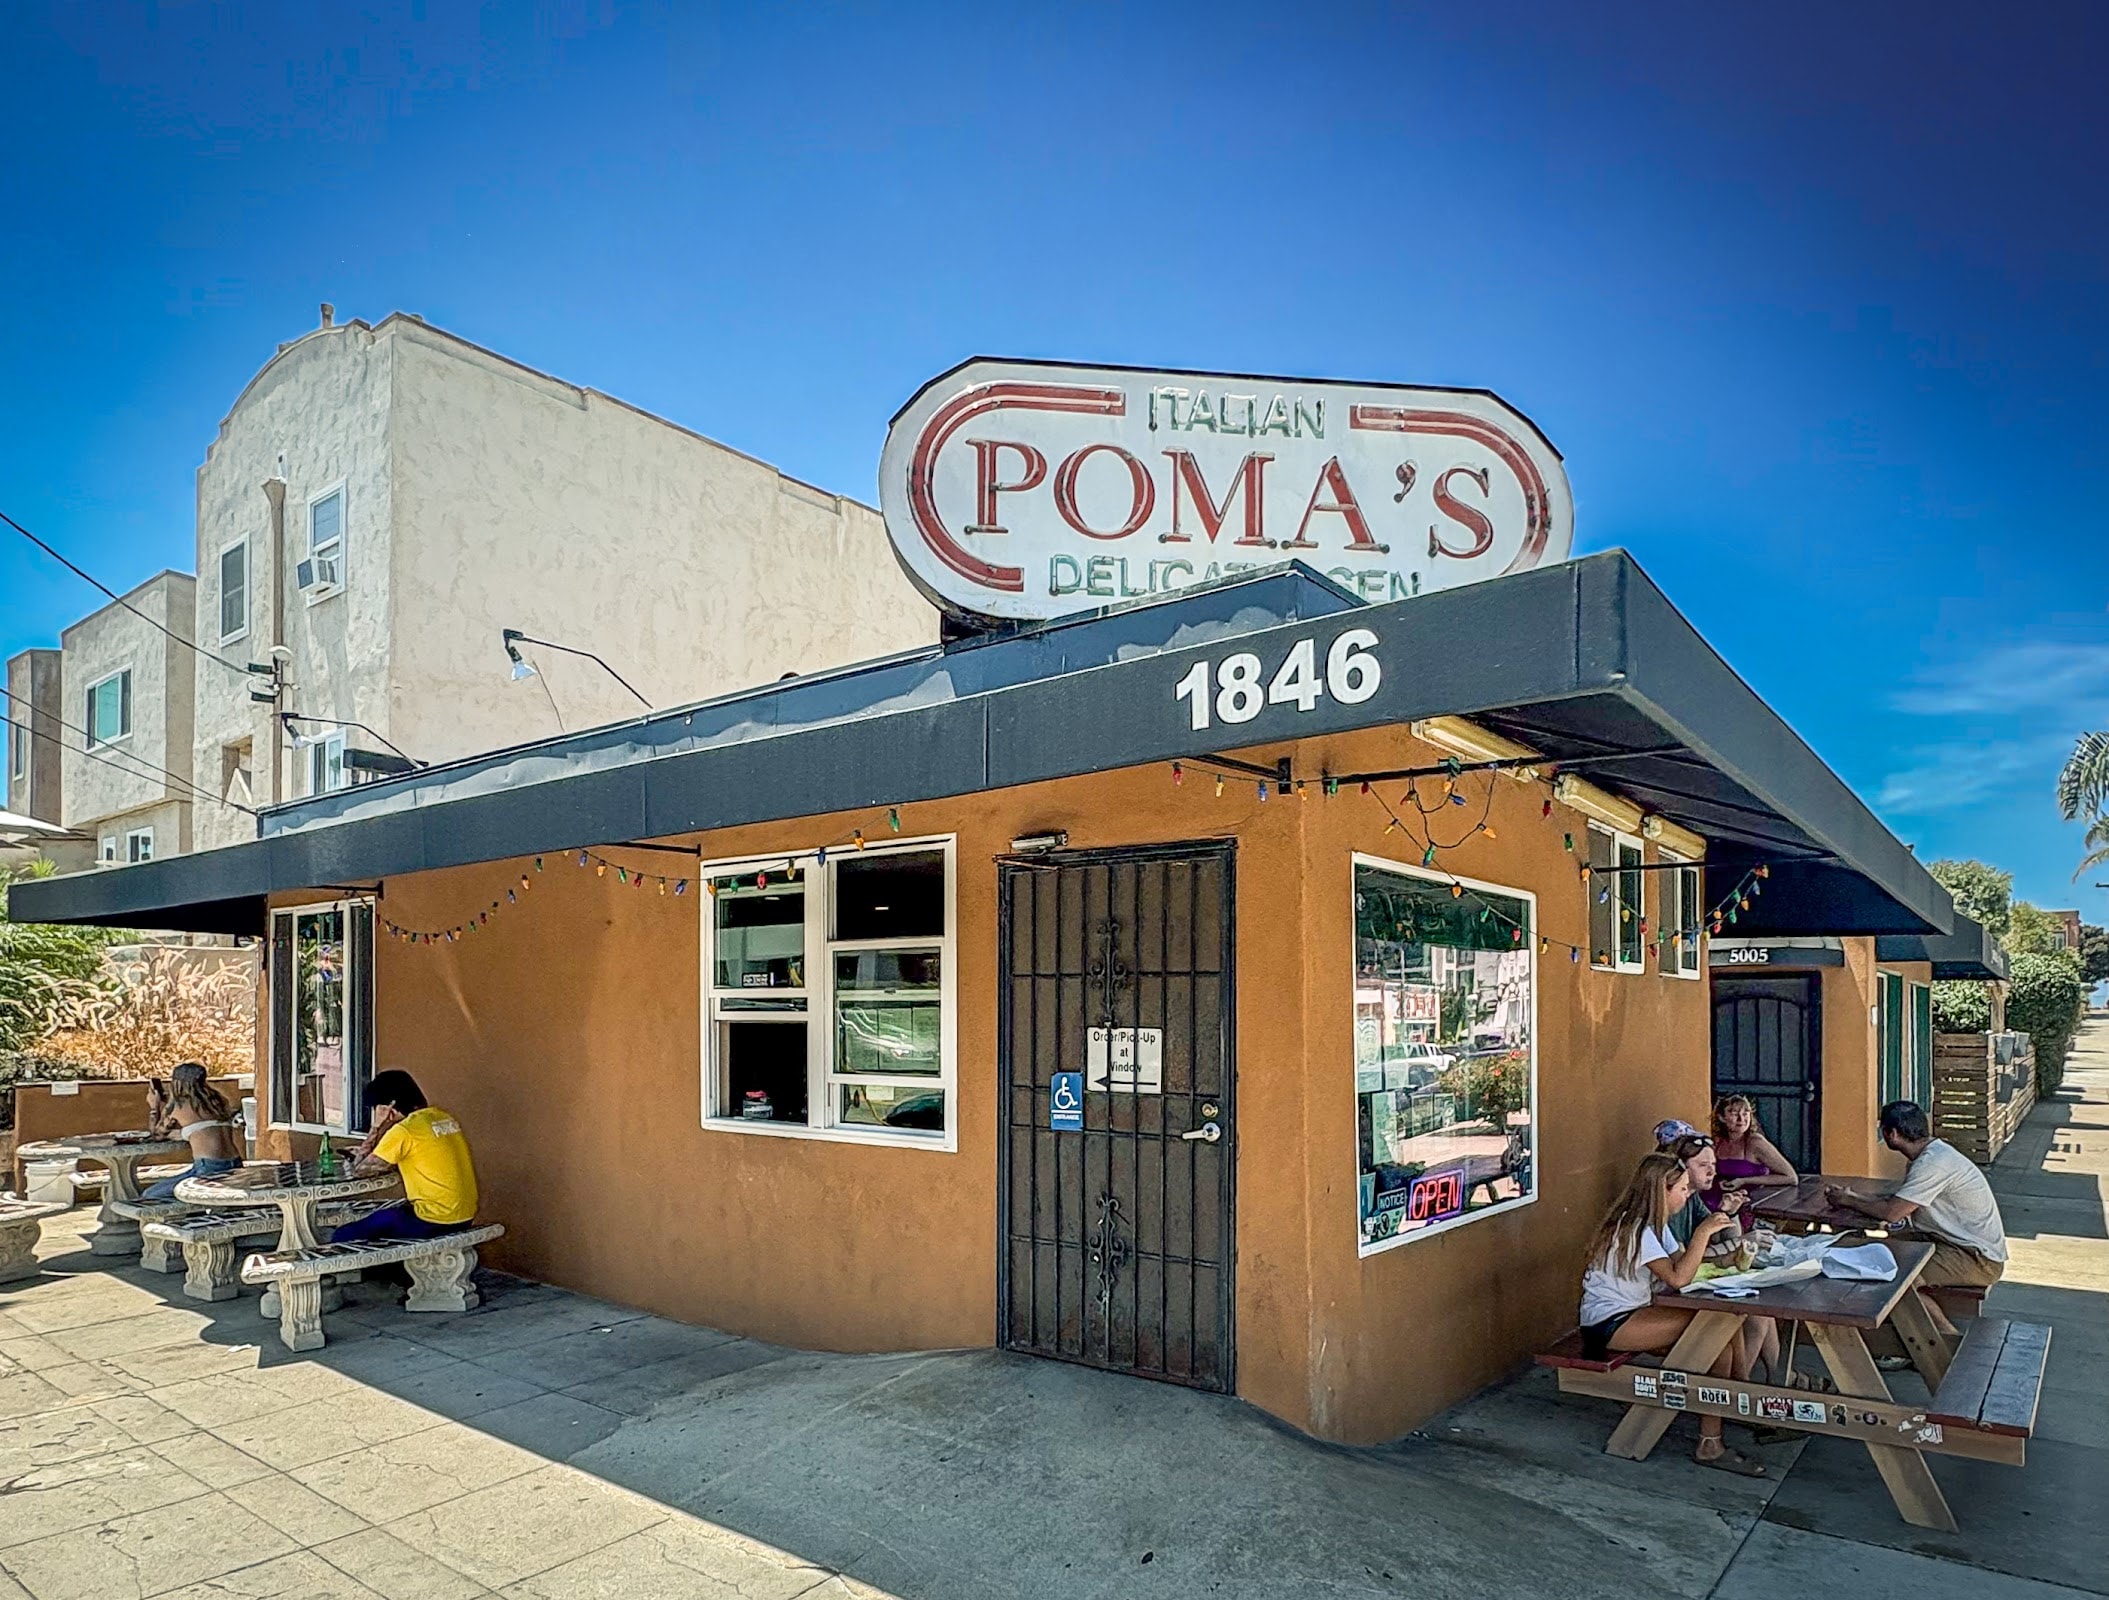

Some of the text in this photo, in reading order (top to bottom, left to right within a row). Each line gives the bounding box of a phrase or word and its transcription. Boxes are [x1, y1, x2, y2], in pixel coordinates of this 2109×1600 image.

[1149, 386, 1325, 438] ITALIAN
[964, 438, 1494, 559] POMA'S
[1049, 553, 1423, 602] DELICEN
[1175, 628, 1382, 731] 1846
[1729, 948, 1769, 963] 5005
[1119, 1047, 1129, 1058] at
[1380, 1193, 1405, 1209] NOTICE
[1412, 1175, 1460, 1220] OPEN
